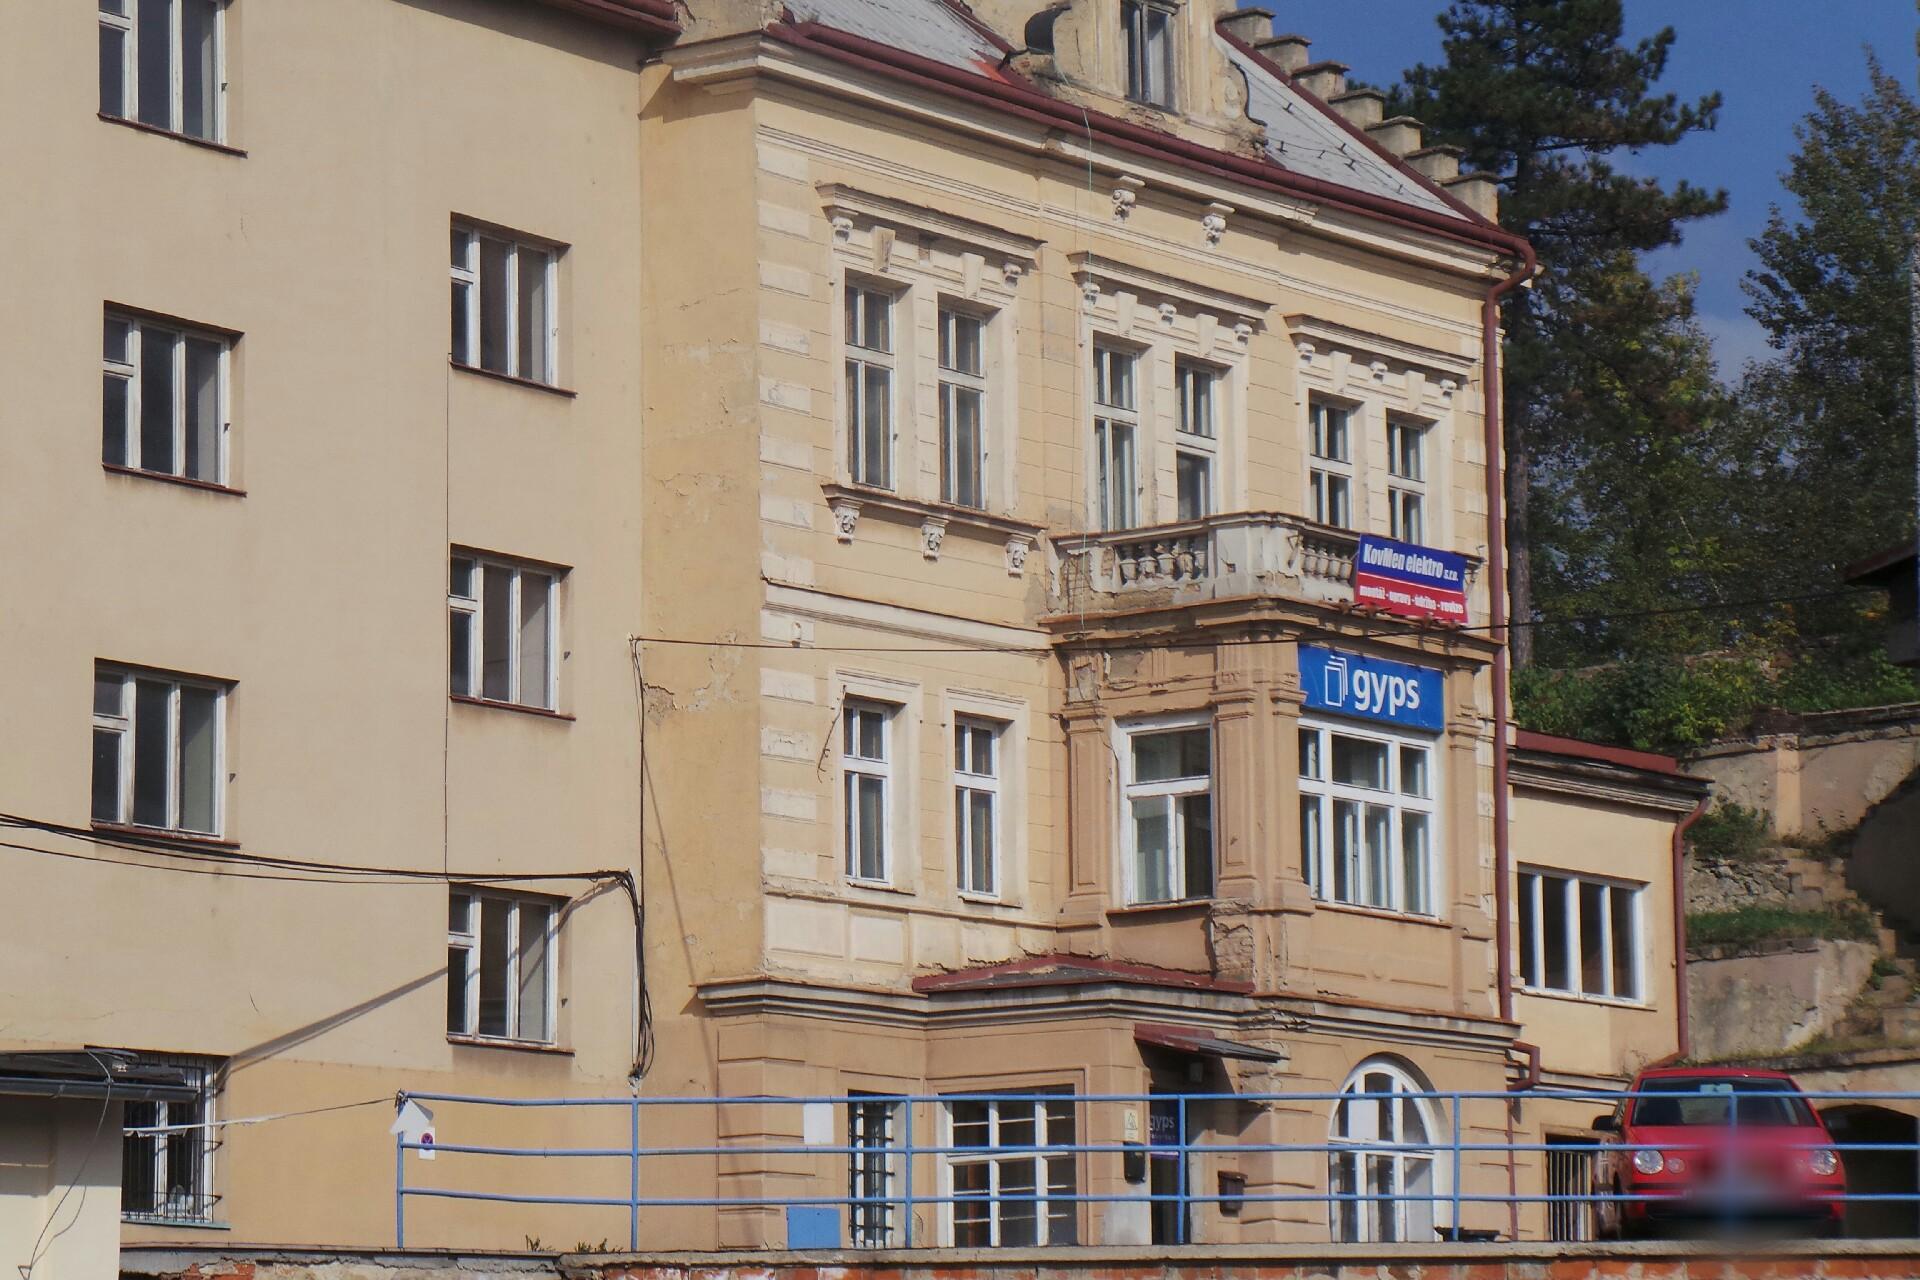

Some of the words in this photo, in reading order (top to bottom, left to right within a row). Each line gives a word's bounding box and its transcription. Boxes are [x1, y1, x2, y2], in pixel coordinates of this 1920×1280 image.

[1363, 544, 1405, 569] KovMen
[1406, 554, 1443, 578] elektro
[1353, 669, 1420, 715] gyps
